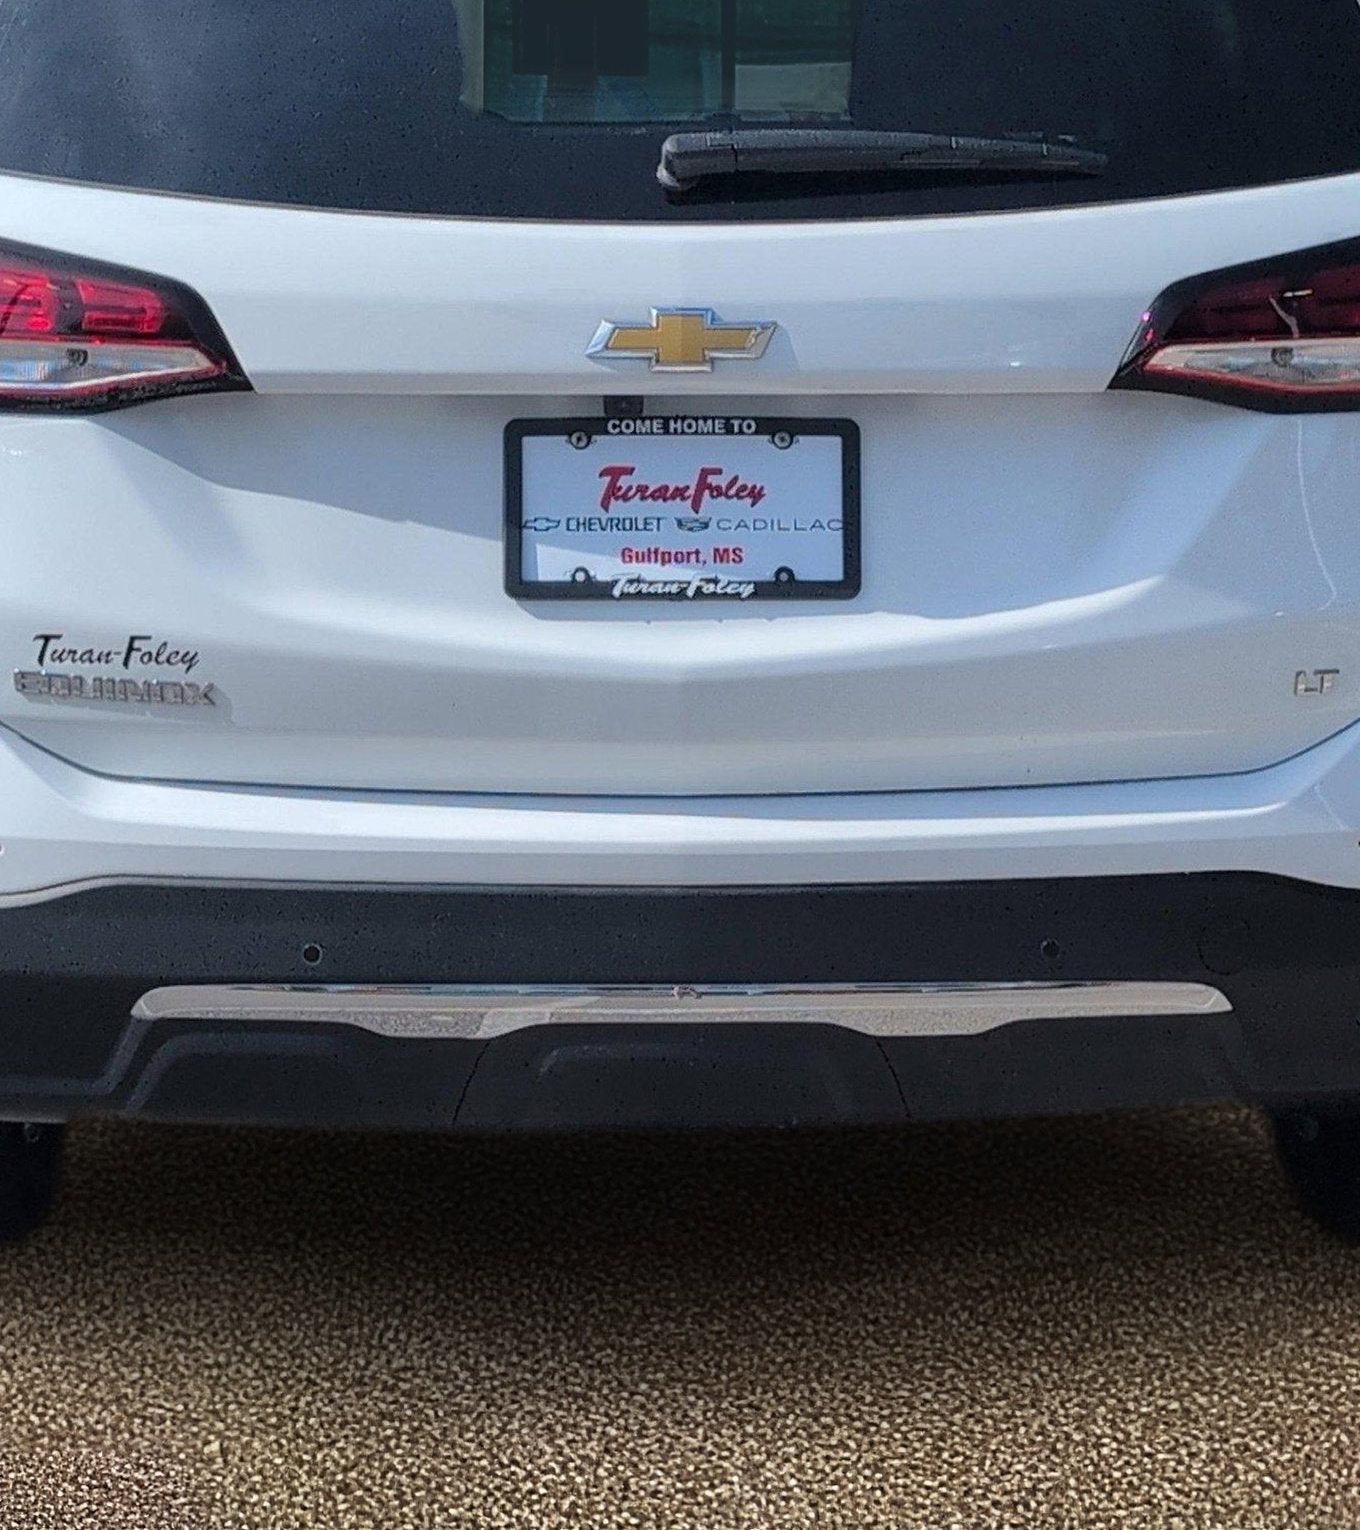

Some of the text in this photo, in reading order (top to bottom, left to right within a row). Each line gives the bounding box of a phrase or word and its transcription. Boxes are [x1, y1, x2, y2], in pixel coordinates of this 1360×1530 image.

[607, 419, 757, 434] COME HOME TO
[566, 517, 843, 532] CHEVROLET CADILLAC
[621, 546, 744, 566] Gulfport, MS
[1294, 669, 1340, 696] LT
